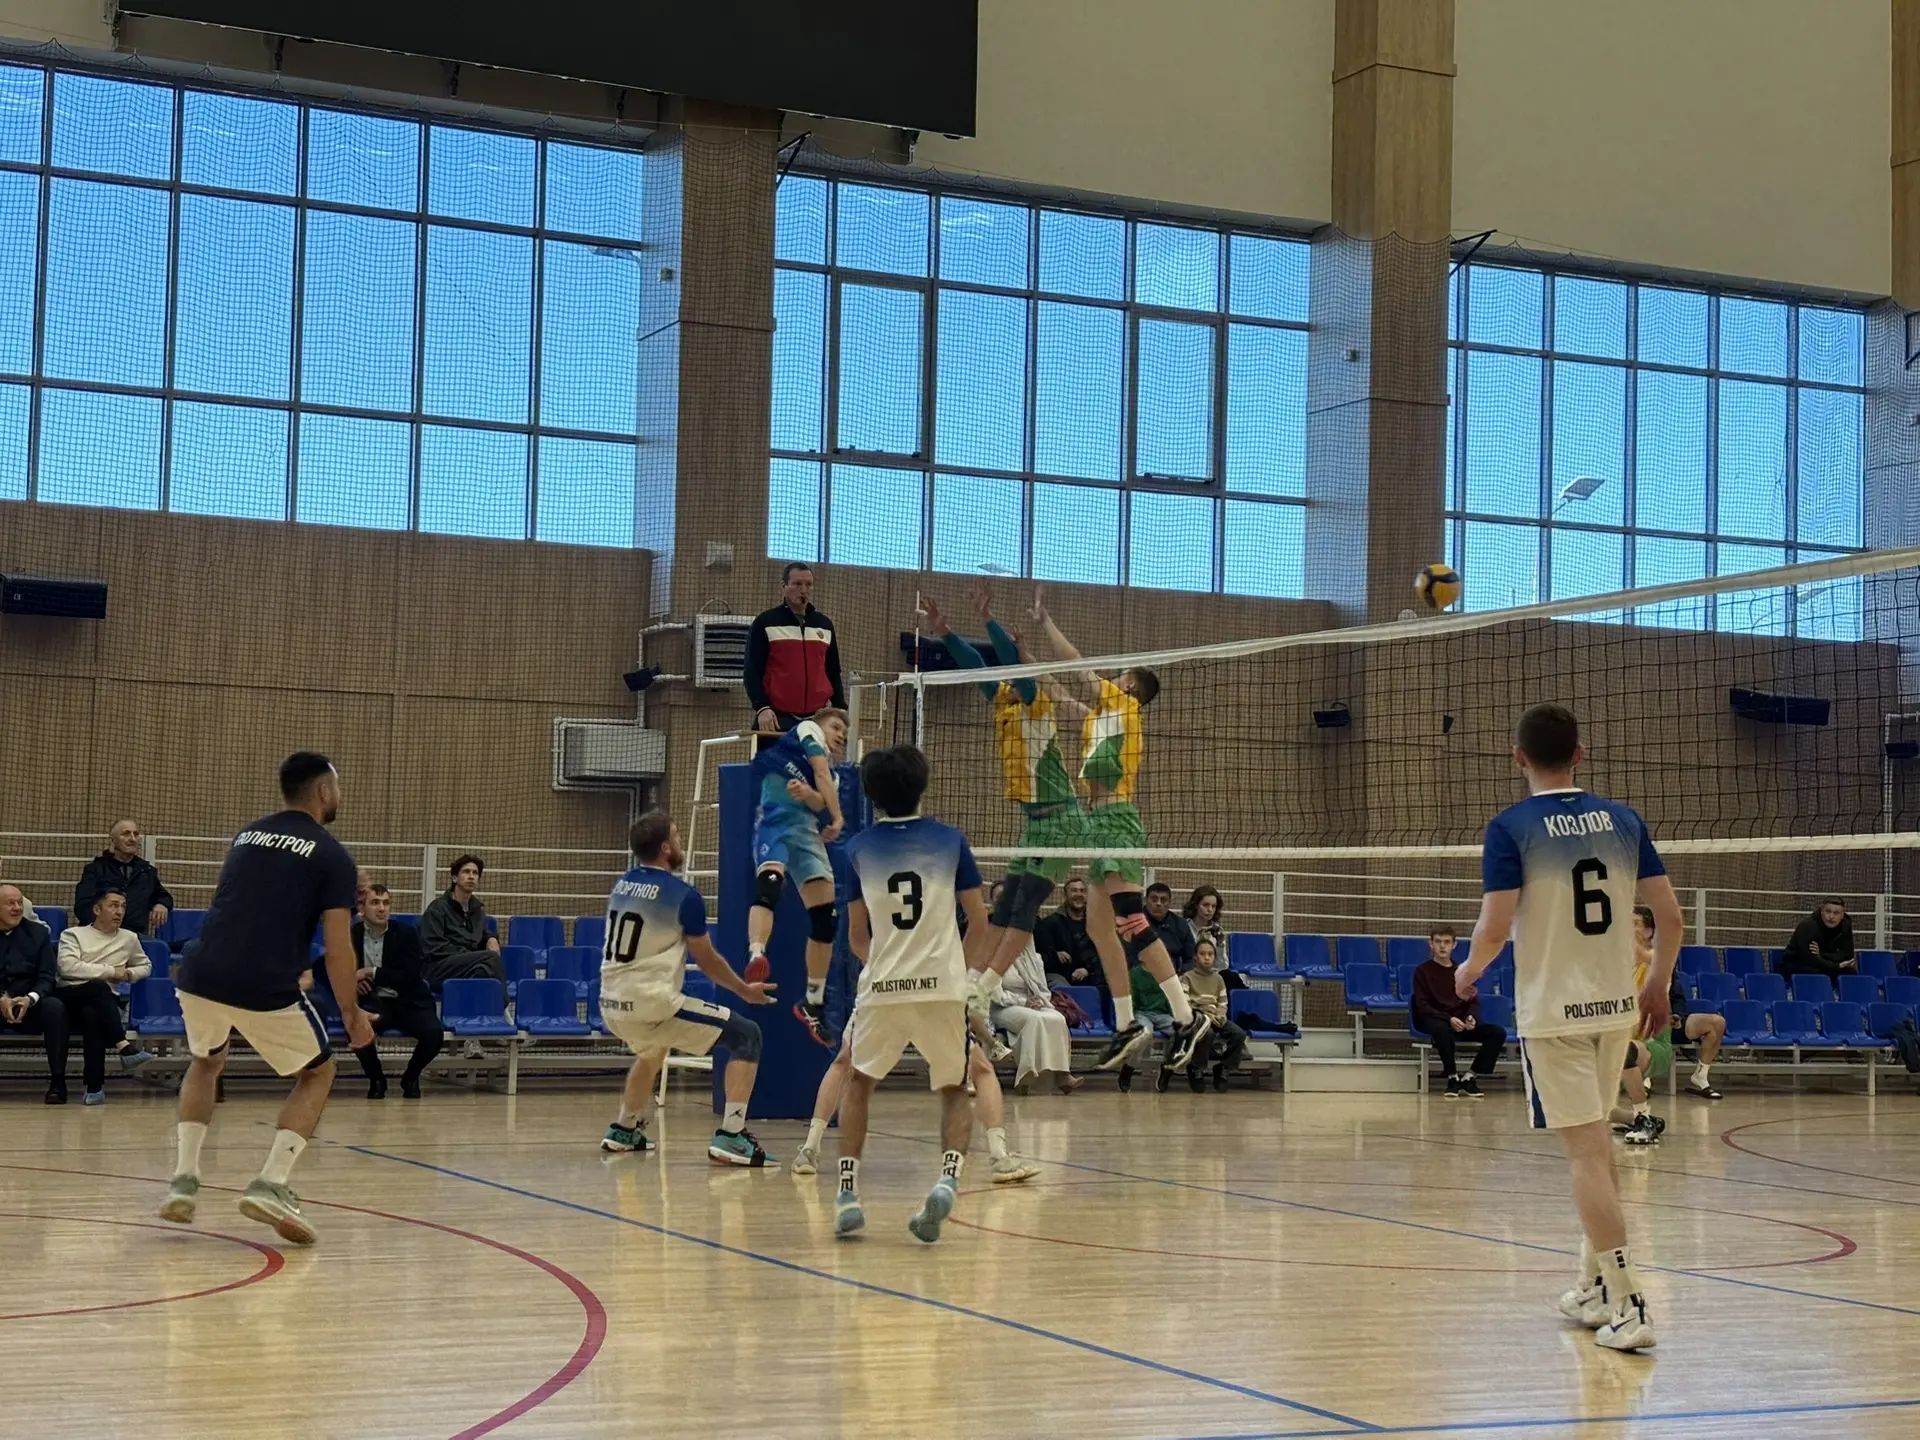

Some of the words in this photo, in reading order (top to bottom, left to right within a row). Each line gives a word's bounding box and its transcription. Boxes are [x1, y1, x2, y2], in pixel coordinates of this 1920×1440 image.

[1543, 810, 1614, 838] КОЗЛОВ
[887, 870, 923, 930] 3
[1571, 857, 1612, 936] 6
[606, 909, 644, 963] 10
[872, 977, 938, 993] POLISTROY.NET
[1564, 996, 1635, 1020] POLISTROY.NET
